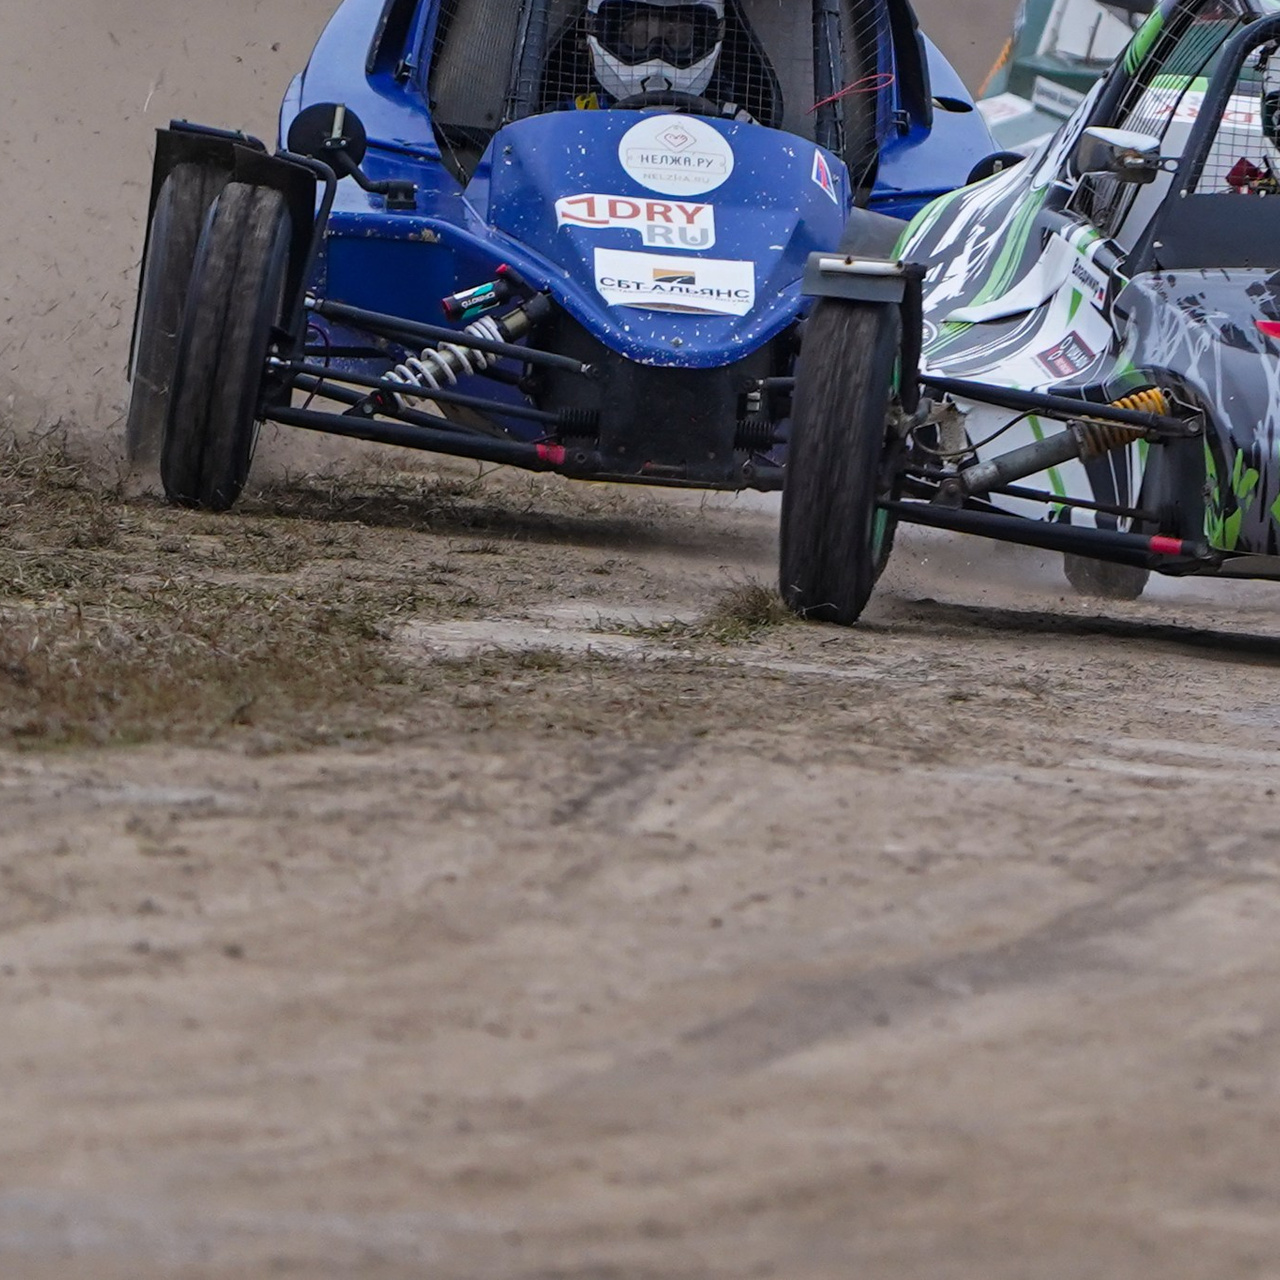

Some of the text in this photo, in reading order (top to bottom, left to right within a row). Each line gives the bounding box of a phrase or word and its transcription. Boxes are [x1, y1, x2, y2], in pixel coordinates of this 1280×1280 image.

[640, 154, 714, 168] НЕЛЖА.РУ
[563, 196, 705, 224] 1DRY
[647, 224, 709, 246] RU
[599, 277, 750, 299] СБТ-АЛЬЯНС
